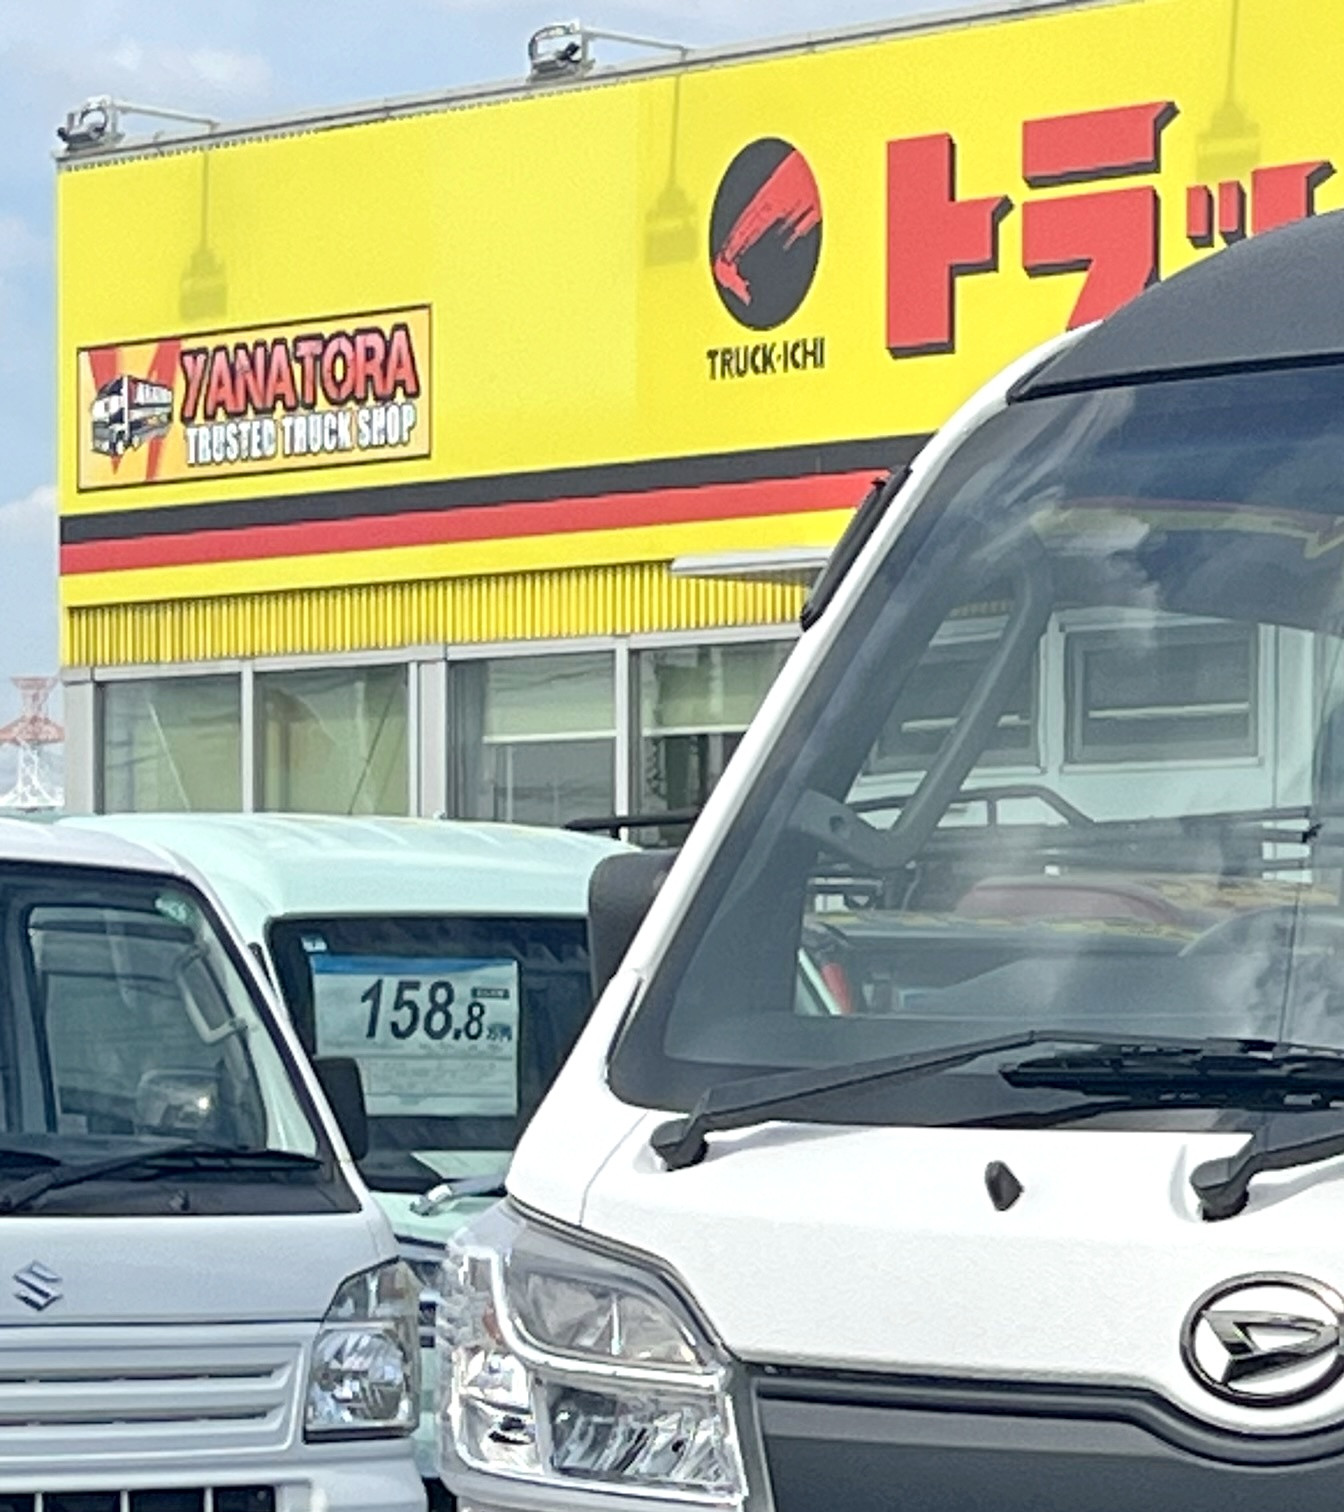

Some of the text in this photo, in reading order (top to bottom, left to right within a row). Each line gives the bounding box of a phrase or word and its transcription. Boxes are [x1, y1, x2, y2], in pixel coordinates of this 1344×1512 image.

[180, 323, 421, 424] YANATORA
[186, 401, 417, 468] TRUSTED TRUCK SHOP
[360, 978, 486, 1041] 158.8
